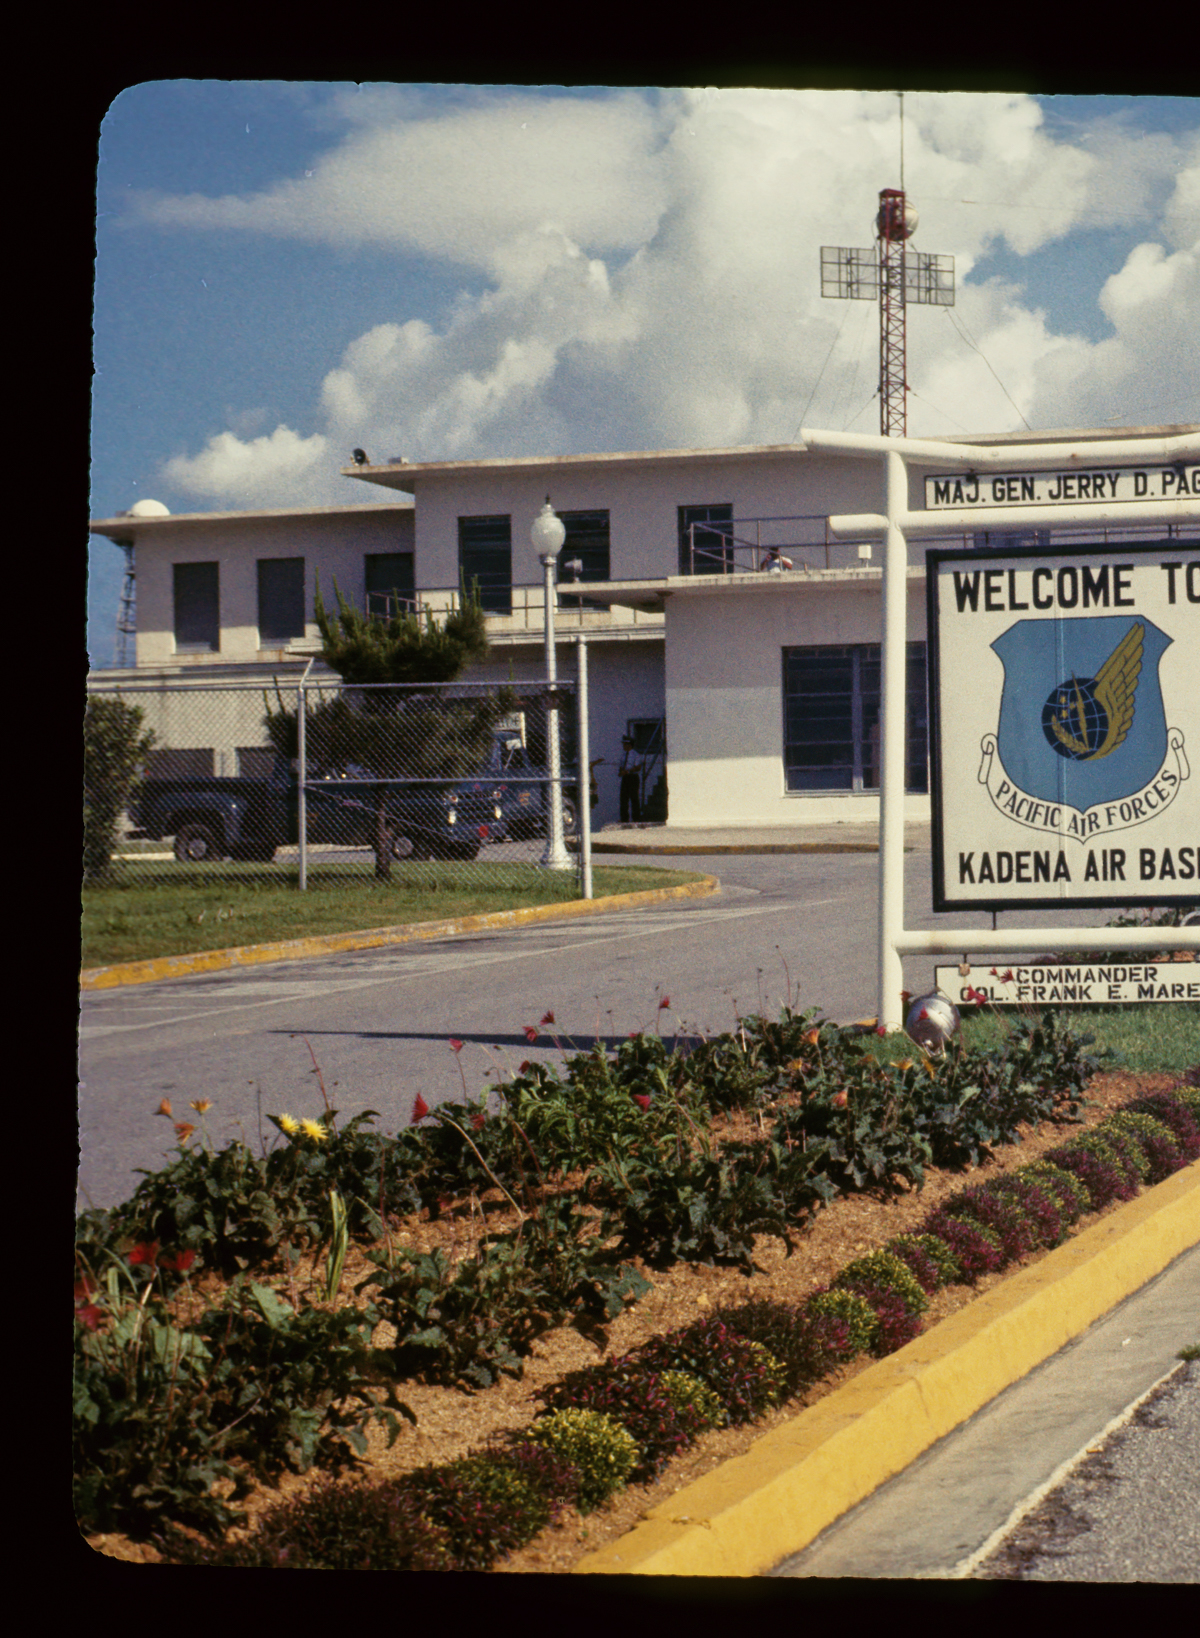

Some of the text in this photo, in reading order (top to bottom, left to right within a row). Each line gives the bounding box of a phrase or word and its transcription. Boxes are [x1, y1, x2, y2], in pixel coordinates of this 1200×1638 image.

[933, 478, 986, 505] MAJ.
[992, 476, 1042, 502] GEN.
[1048, 473, 1121, 500] JERRY
[1133, 471, 1156, 497] D.
[952, 563, 1136, 613] WELCOME
[995, 769, 1179, 837] PACIFIC AIR FORCES
[958, 850, 1072, 885] KADENA
[1083, 848, 1127, 882] AIR
[1015, 966, 1159, 985] COMMANDER
[1016, 985, 1093, 1002] FRANK
[1107, 984, 1129, 1000] E.
